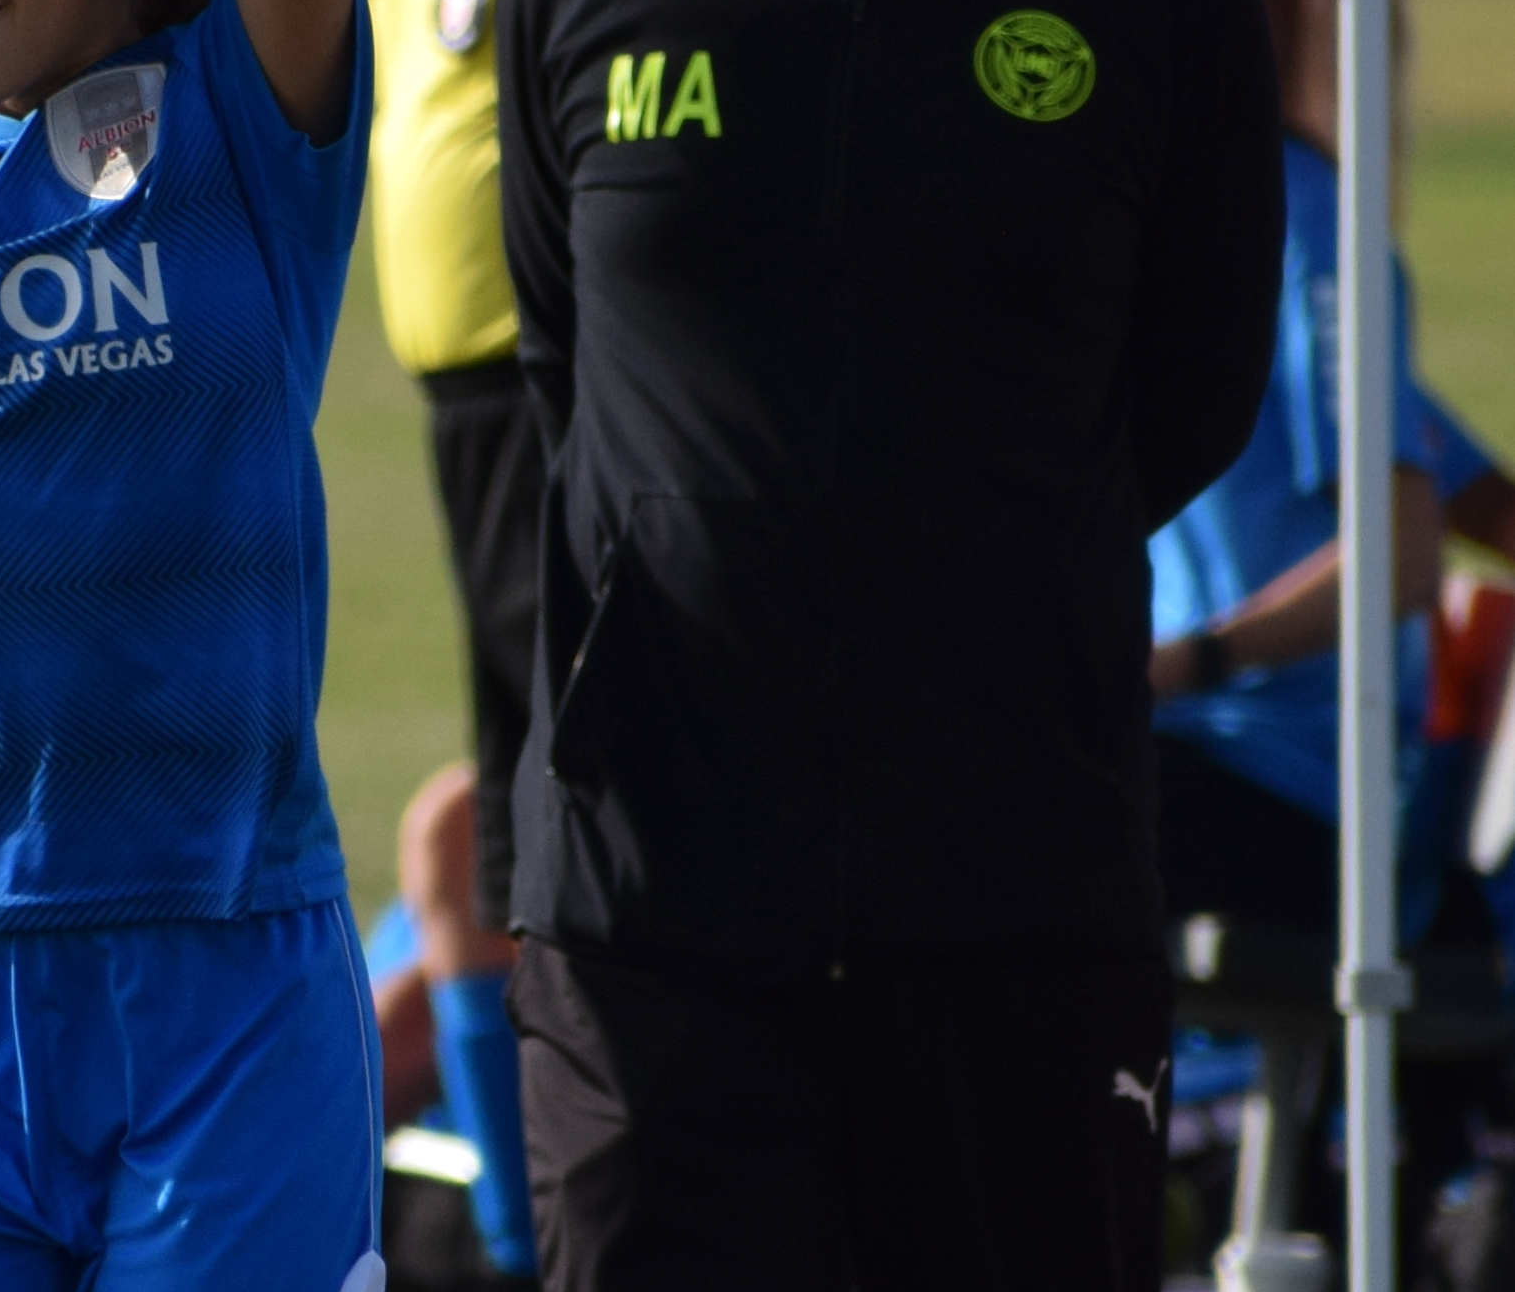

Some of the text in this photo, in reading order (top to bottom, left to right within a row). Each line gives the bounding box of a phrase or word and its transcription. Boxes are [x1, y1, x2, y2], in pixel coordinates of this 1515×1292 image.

[605, 50, 723, 143] MA
[78, 110, 157, 153] ALBION
[55, 334, 174, 377] VEGAS
